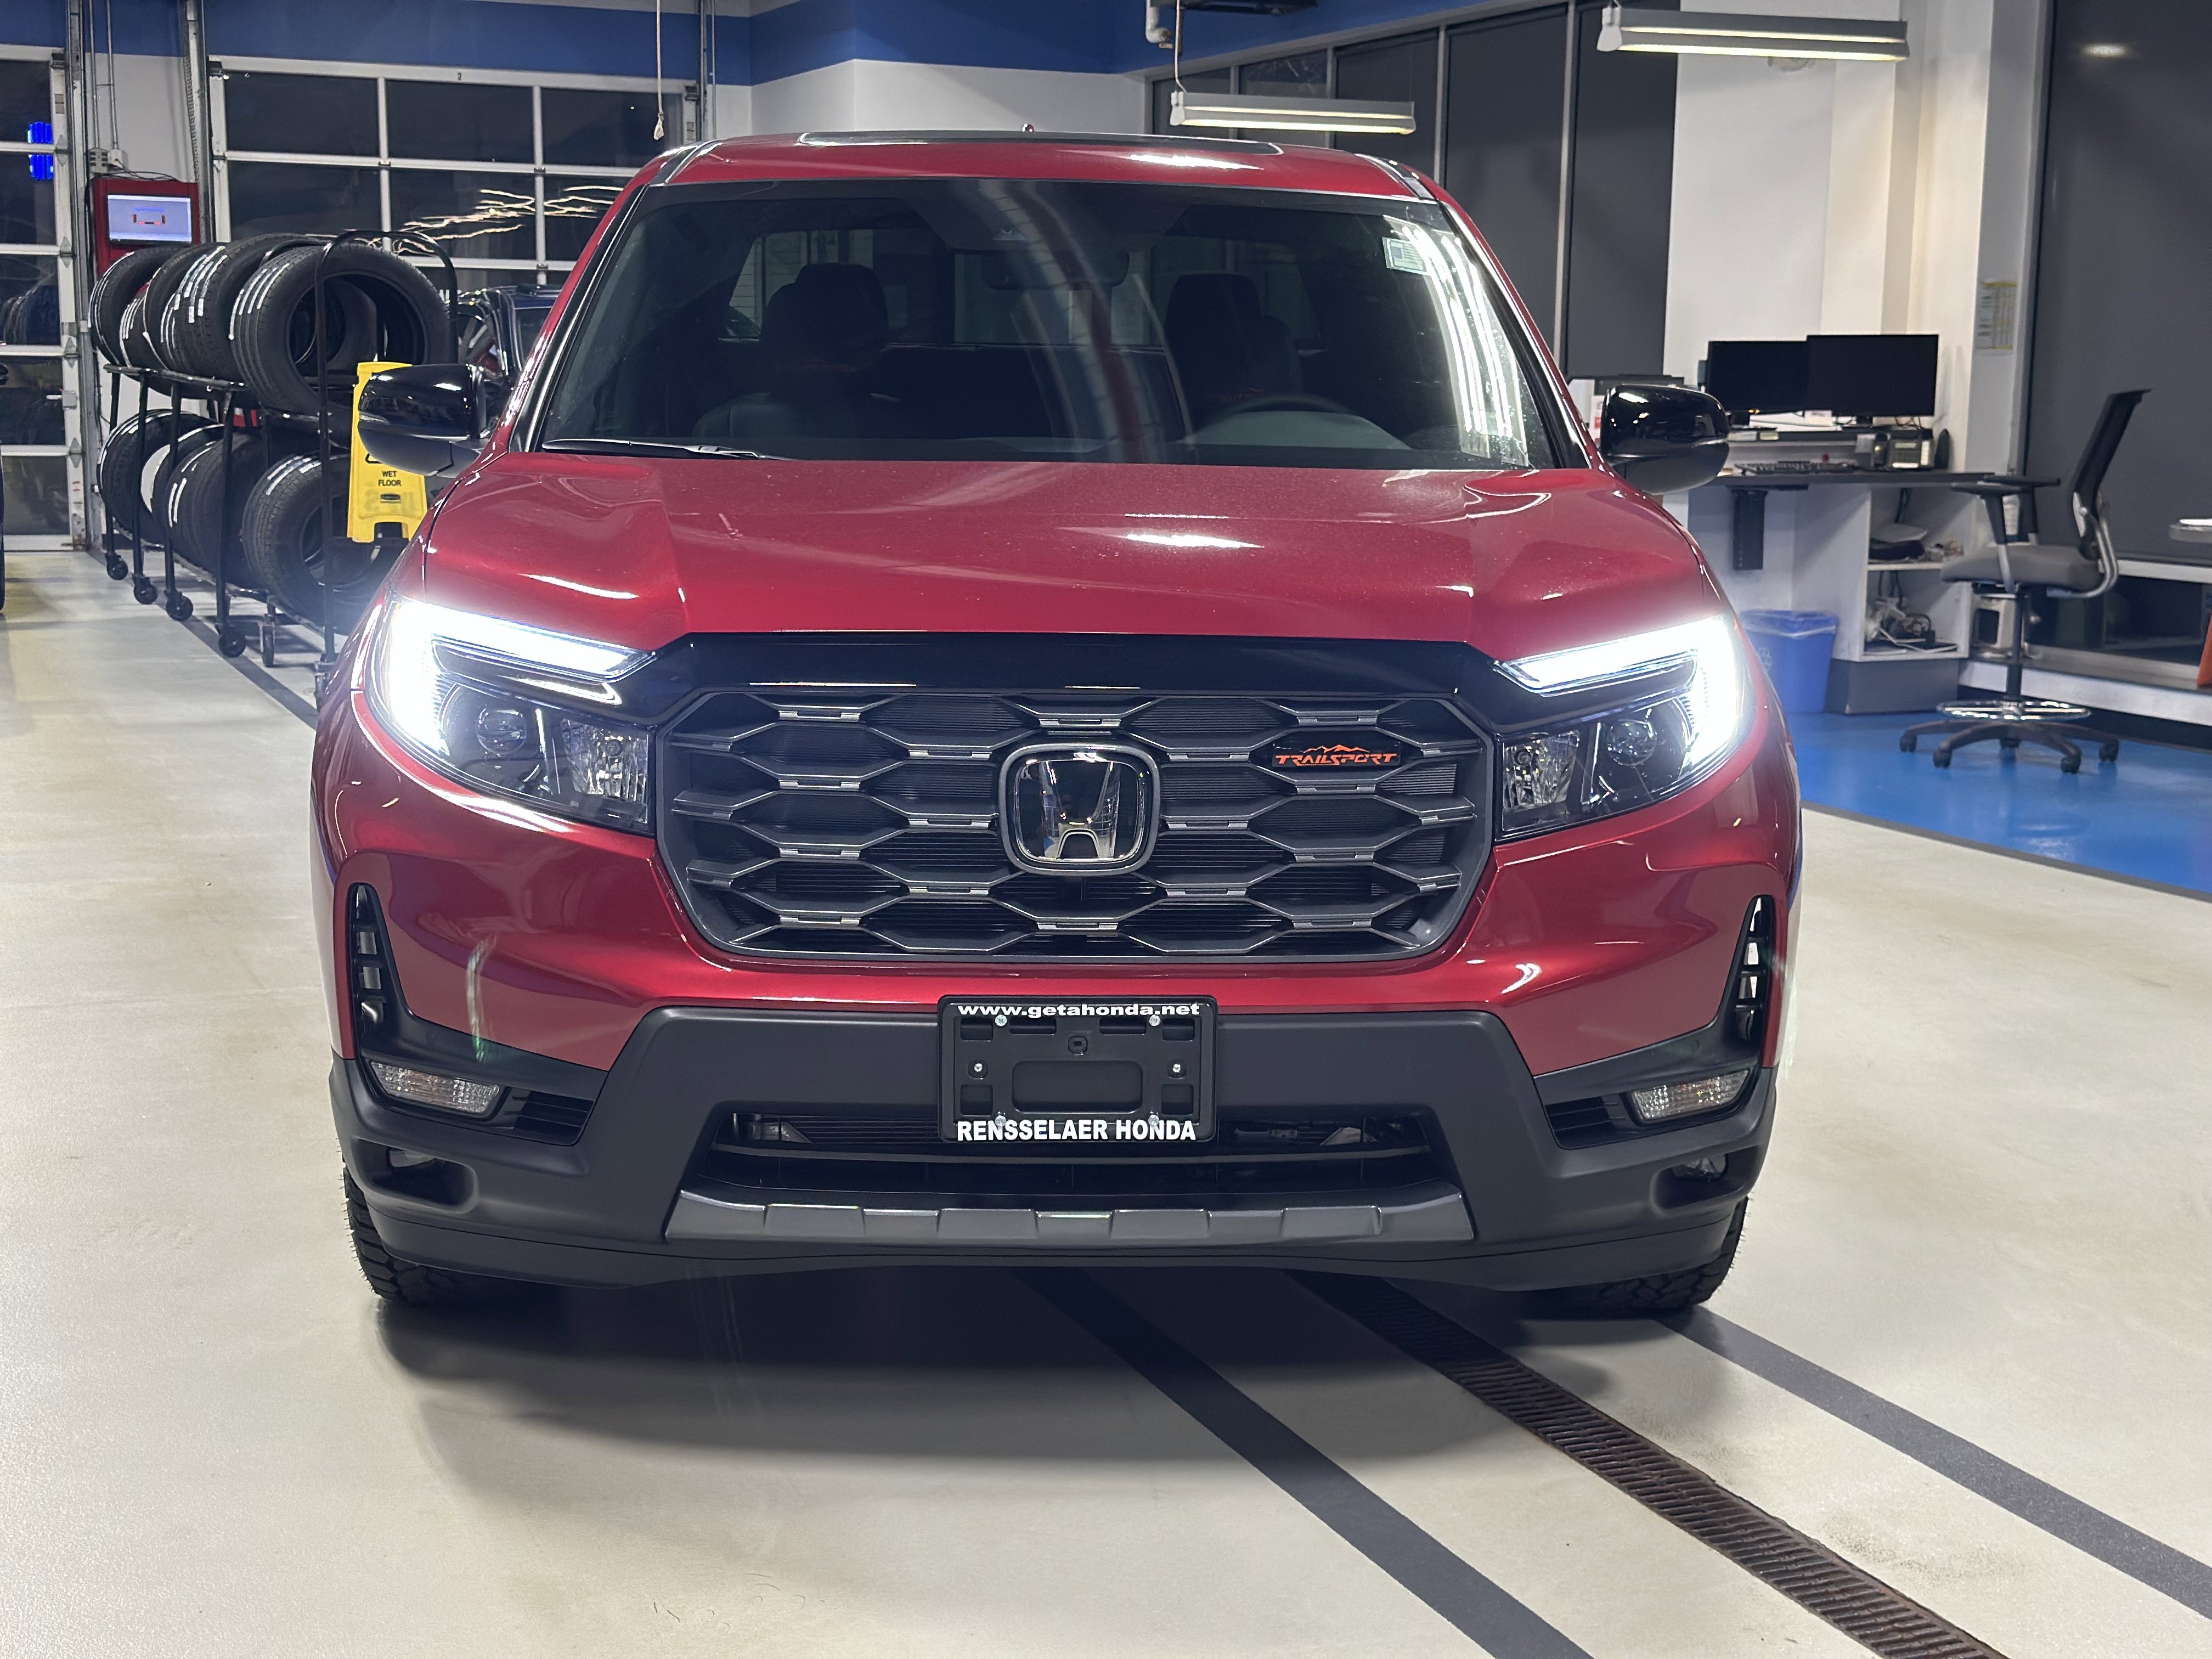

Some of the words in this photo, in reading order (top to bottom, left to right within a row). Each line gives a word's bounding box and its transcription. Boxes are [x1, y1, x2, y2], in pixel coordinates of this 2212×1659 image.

[1276, 753, 1397, 766] TRAILSPORT
[957, 1003, 1200, 1018] www.getahonda.net
[957, 1120, 1108, 1141] RENSSELAER
[1116, 1120, 1197, 1141] HONDA
